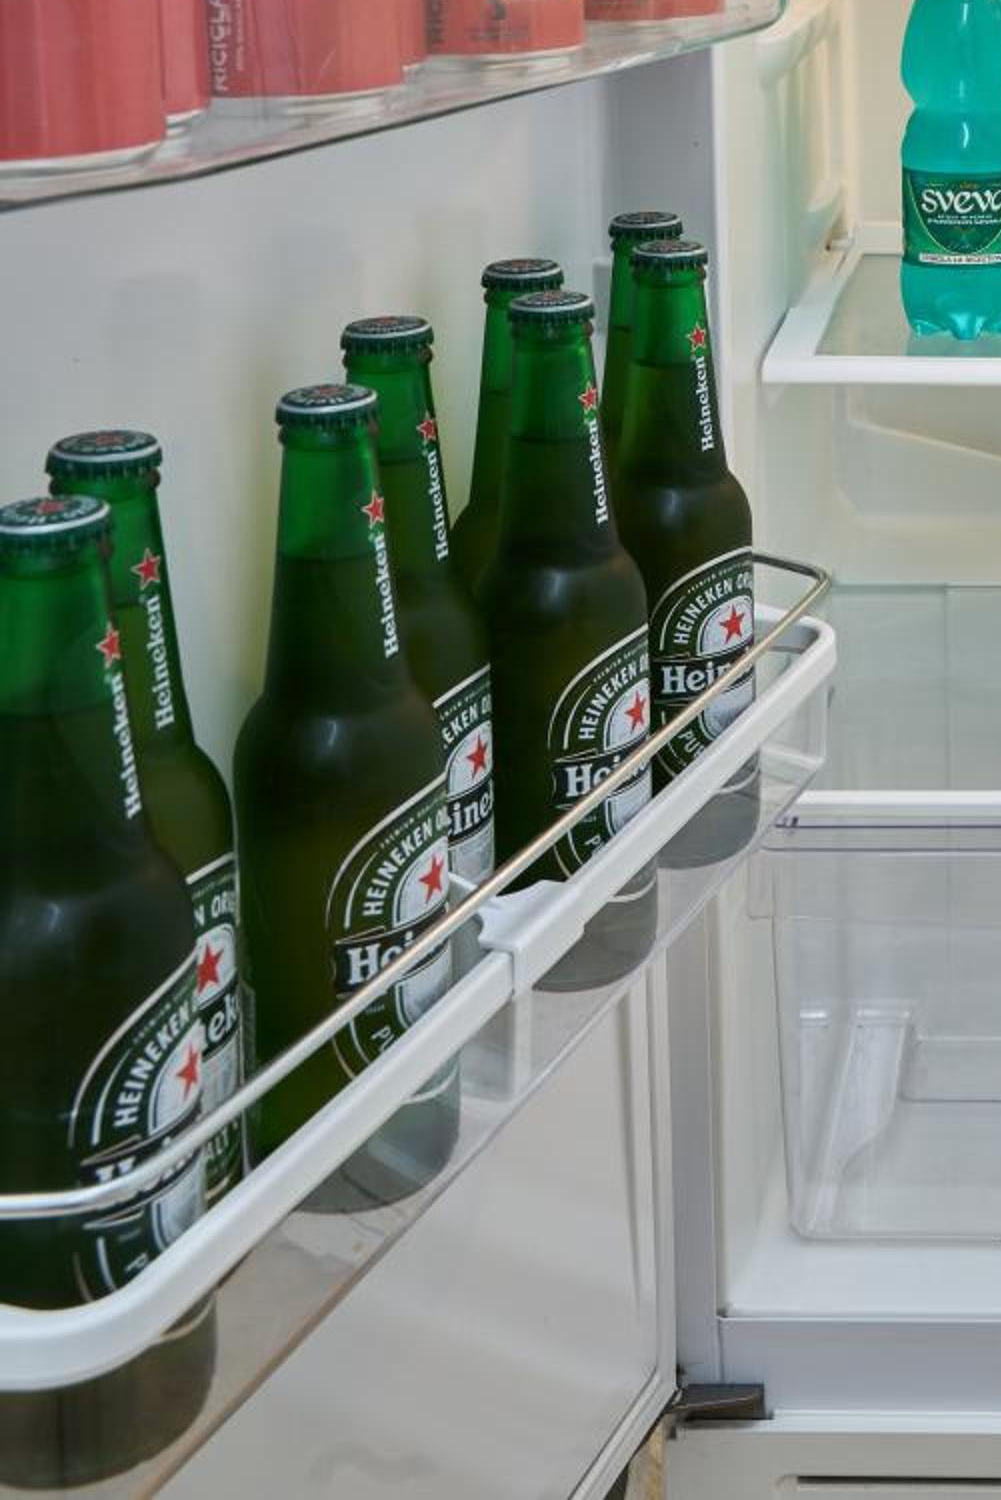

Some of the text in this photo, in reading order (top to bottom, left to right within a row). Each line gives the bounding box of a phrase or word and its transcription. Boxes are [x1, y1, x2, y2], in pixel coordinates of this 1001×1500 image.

[695, 355, 715, 452] Heineken
[427, 449, 449, 563] Heineken
[587, 419, 609, 525] Heineken
[373, 533, 400, 660] Heineken
[673, 577, 733, 645] HEINEKEN
[144, 595, 175, 730] Heineken
[578, 661, 637, 741] HEINEKEN
[111, 673, 142, 820] Heineken
[362, 817, 433, 917] HEINEKEN
